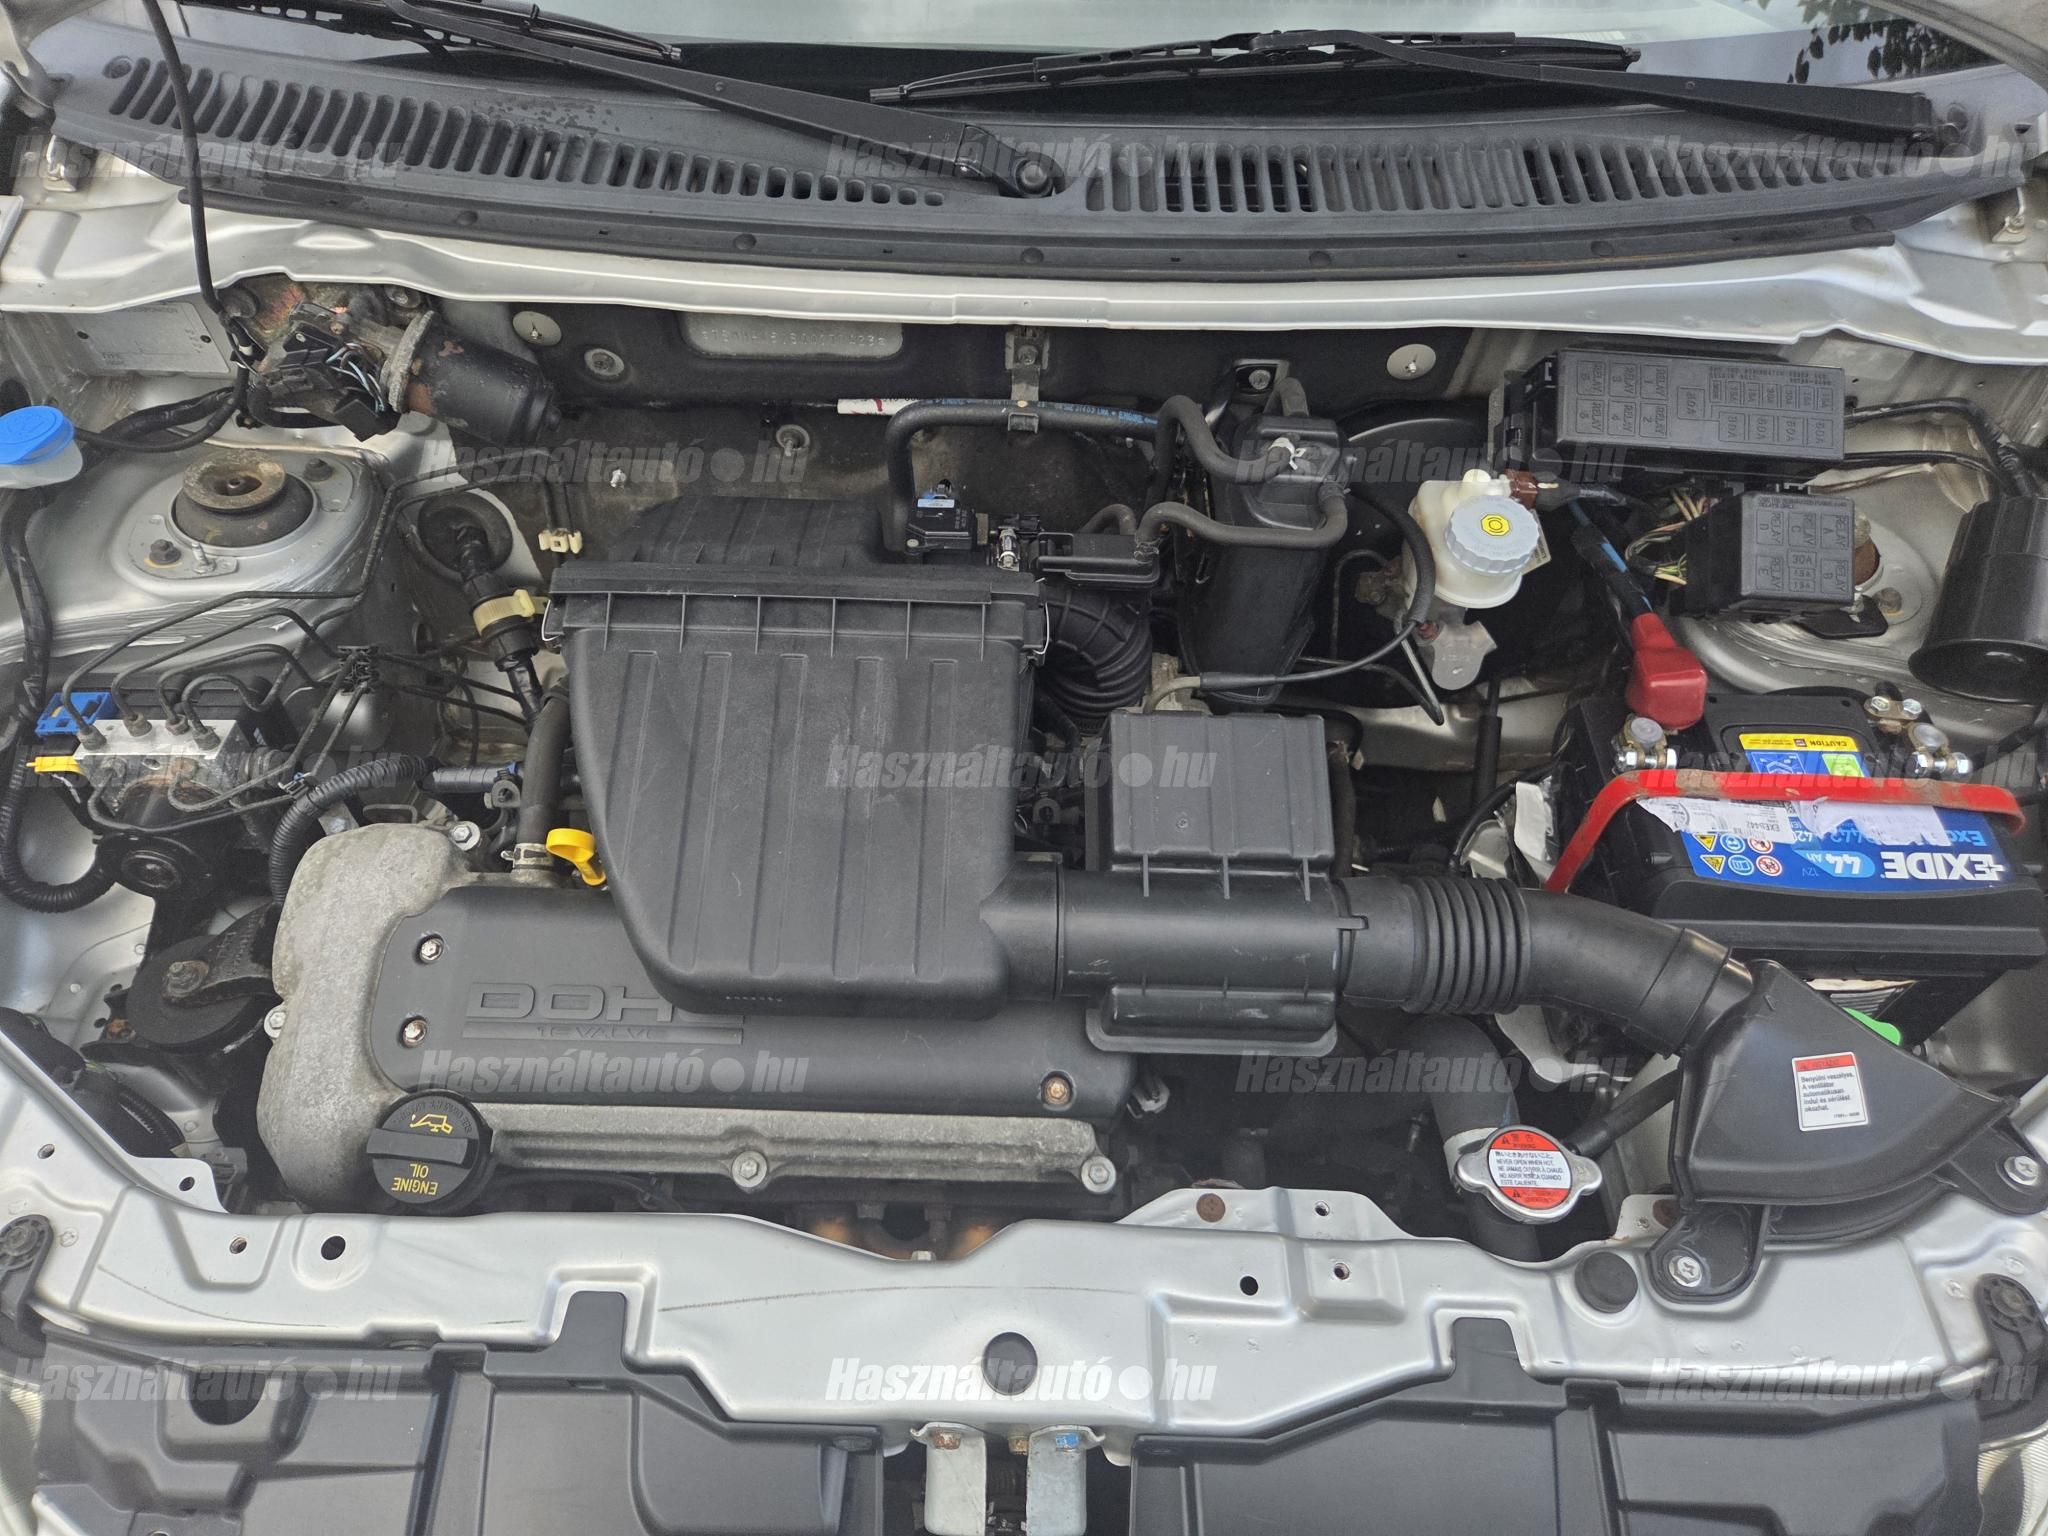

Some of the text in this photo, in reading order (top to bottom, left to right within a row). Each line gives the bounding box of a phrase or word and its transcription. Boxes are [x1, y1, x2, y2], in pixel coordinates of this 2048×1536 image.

[1770, 512, 1781, 544] RELAY
[1835, 515, 1847, 547] RELAY
[1770, 557, 1781, 589] RELAY
[1835, 561, 1846, 592] RELAY
[1808, 738, 1848, 748] CAUTION
[1801, 868, 1820, 877] 12V
[1825, 853, 1861, 874] 44
[1881, 851, 2004, 880] EXIDE
[466, 982, 745, 1023] DOH
[409, 1163, 429, 1179] OIL
[391, 1177, 439, 1195] ENGINE
